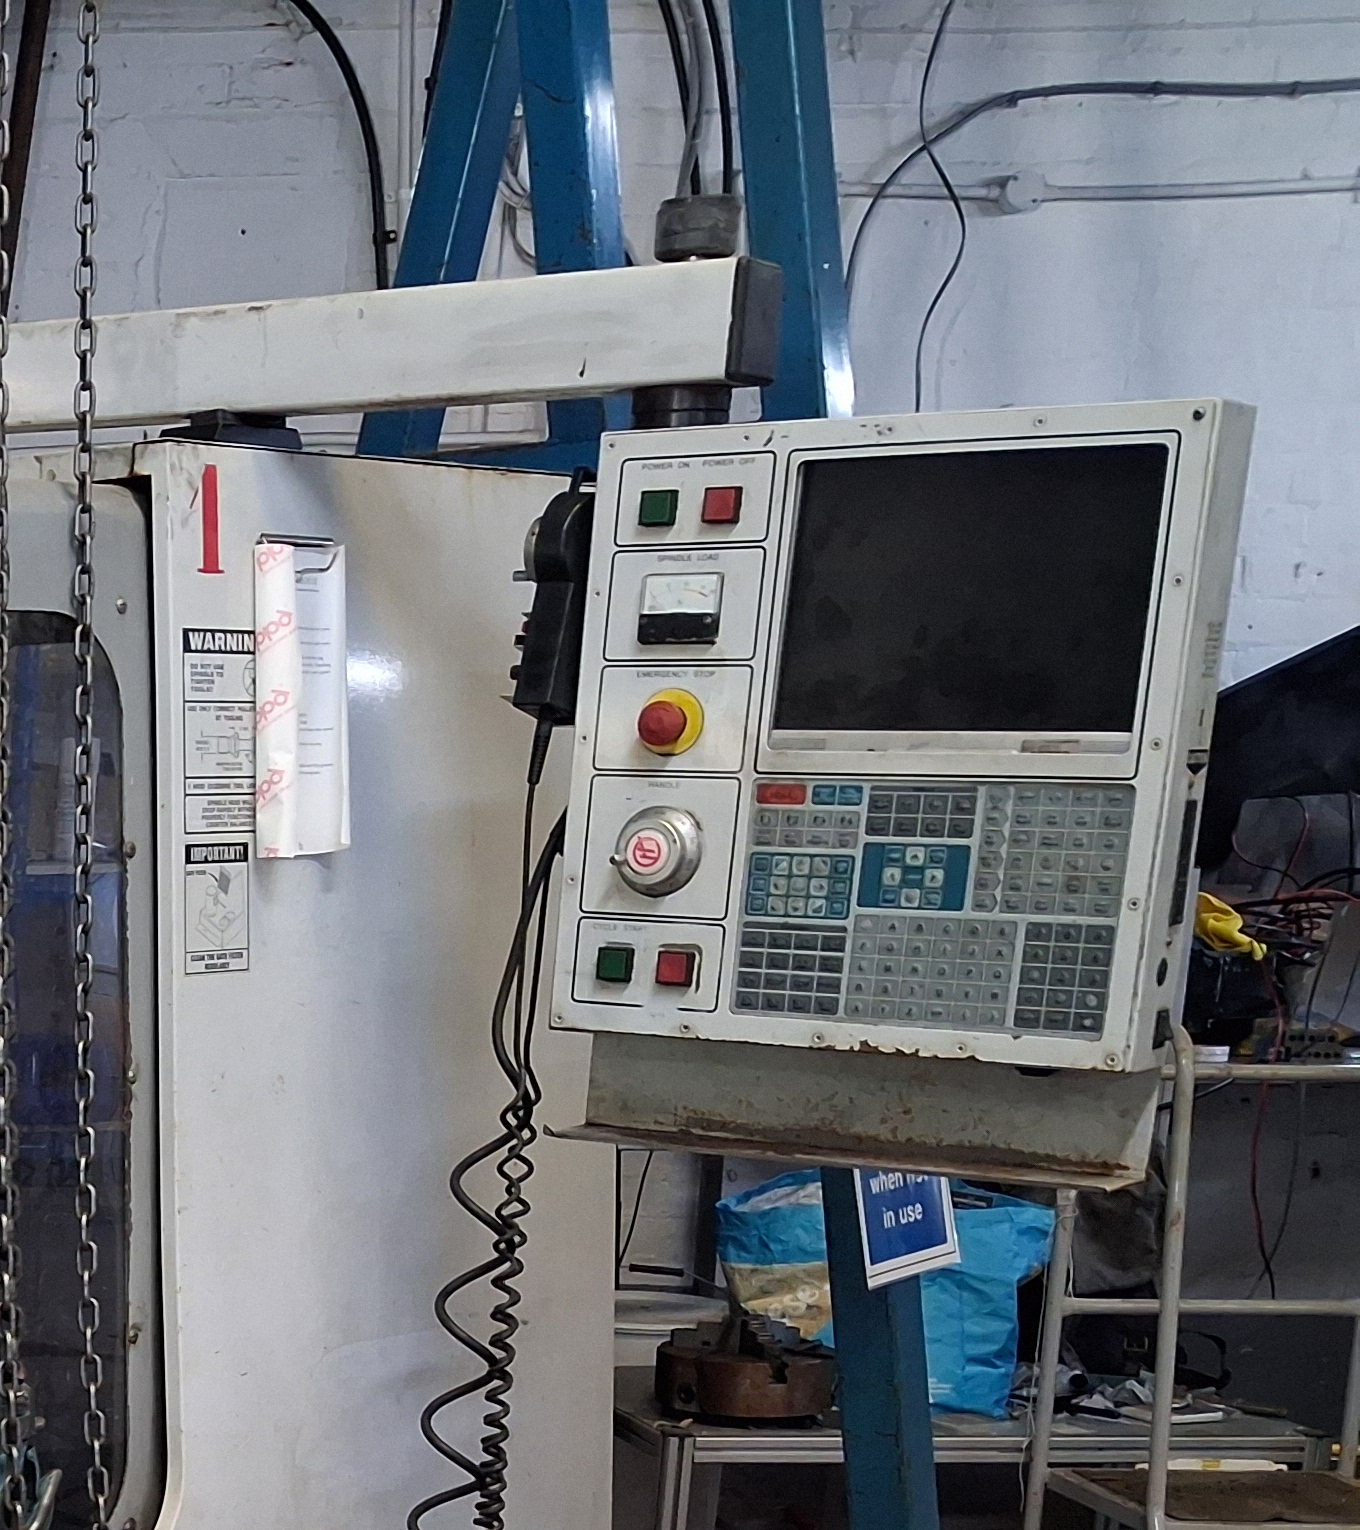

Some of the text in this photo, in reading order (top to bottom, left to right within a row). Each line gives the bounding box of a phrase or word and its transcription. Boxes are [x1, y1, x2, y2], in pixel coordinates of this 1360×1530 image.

[702, 459, 734, 467] POWER
[697, 553, 719, 561] LOAD
[188, 632, 254, 652] WARNIN
[869, 1172, 903, 1195] when
[882, 1202, 923, 1229] in use
